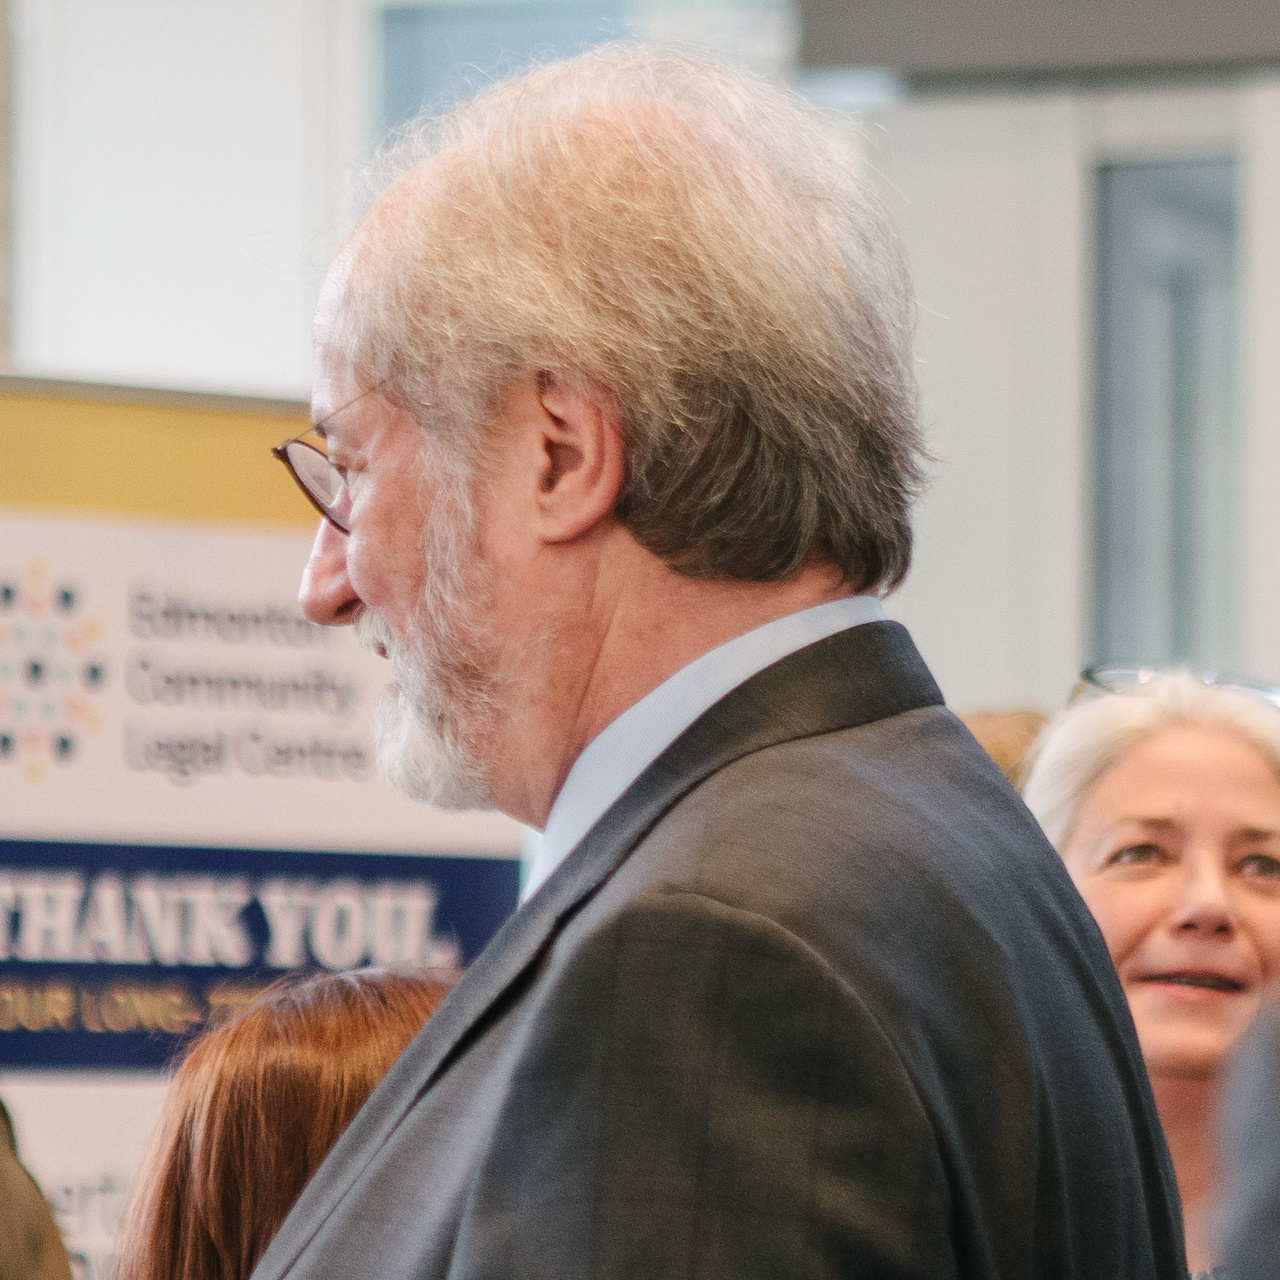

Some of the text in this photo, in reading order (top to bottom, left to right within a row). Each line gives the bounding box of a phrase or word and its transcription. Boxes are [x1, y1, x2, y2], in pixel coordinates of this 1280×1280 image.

[125, 655, 357, 722] Community
[124, 725, 369, 787] Legal Centre
[259, 881, 460, 971] YOU.
